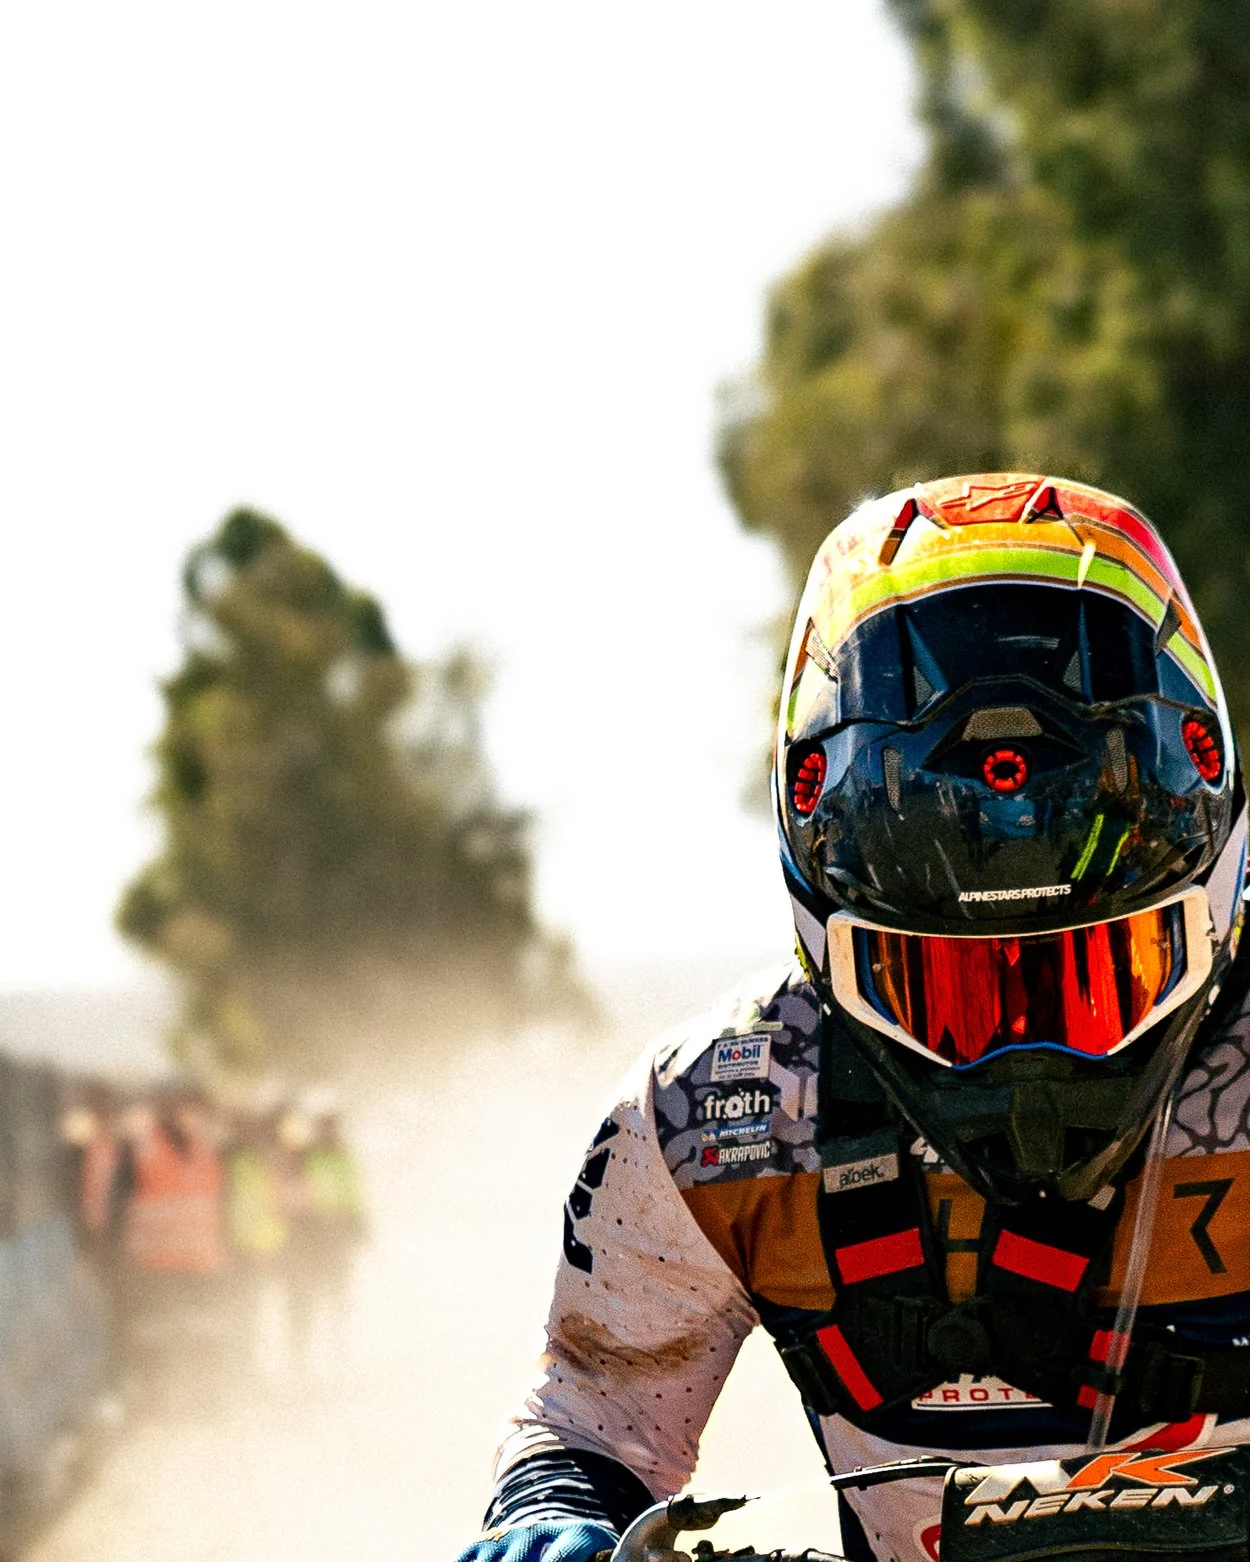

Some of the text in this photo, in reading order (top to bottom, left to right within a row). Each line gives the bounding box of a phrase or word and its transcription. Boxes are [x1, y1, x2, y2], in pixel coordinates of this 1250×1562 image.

[958, 884, 1071, 902] ALPINESTARS PROTECTS
[718, 1045, 762, 1063] Mobil
[704, 1090, 770, 1119] froth
